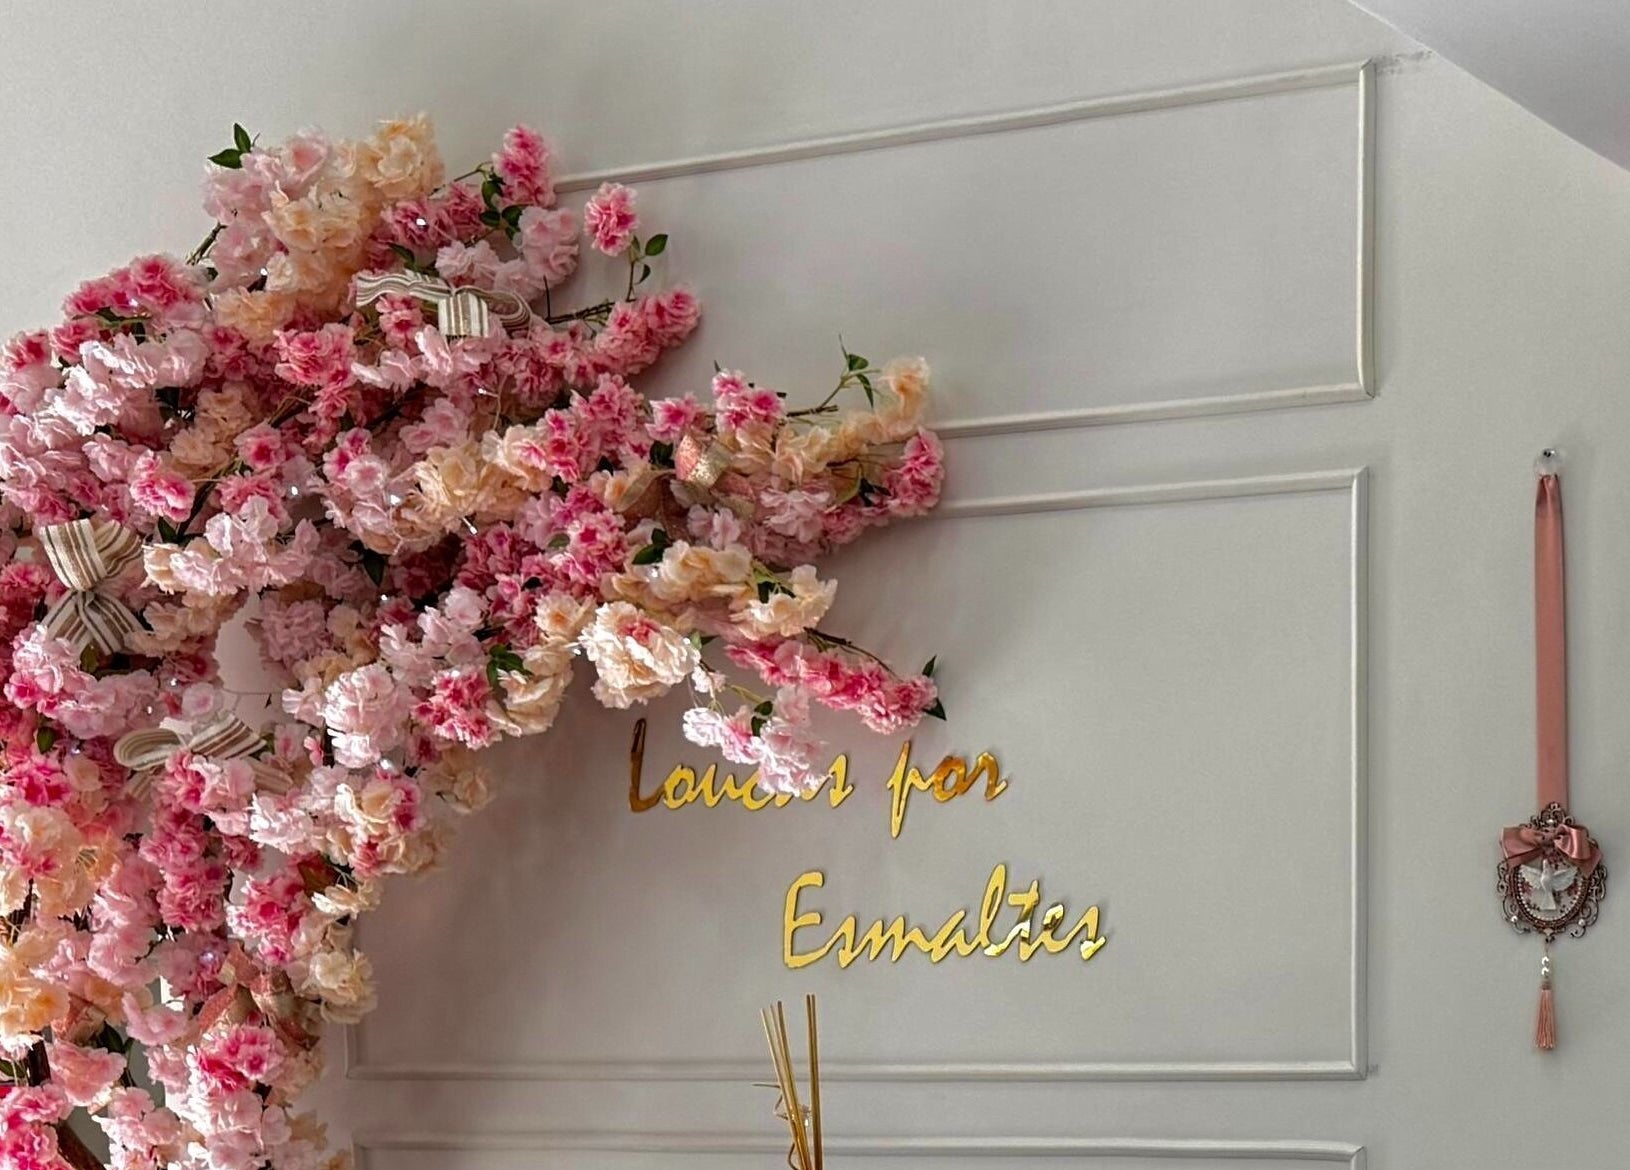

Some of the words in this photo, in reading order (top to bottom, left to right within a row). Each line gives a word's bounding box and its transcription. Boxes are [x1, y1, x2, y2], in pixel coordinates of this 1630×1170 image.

[628, 717, 855, 813] Loucs
[886, 740, 1008, 839] por
[783, 863, 1106, 969] Esmaltes
